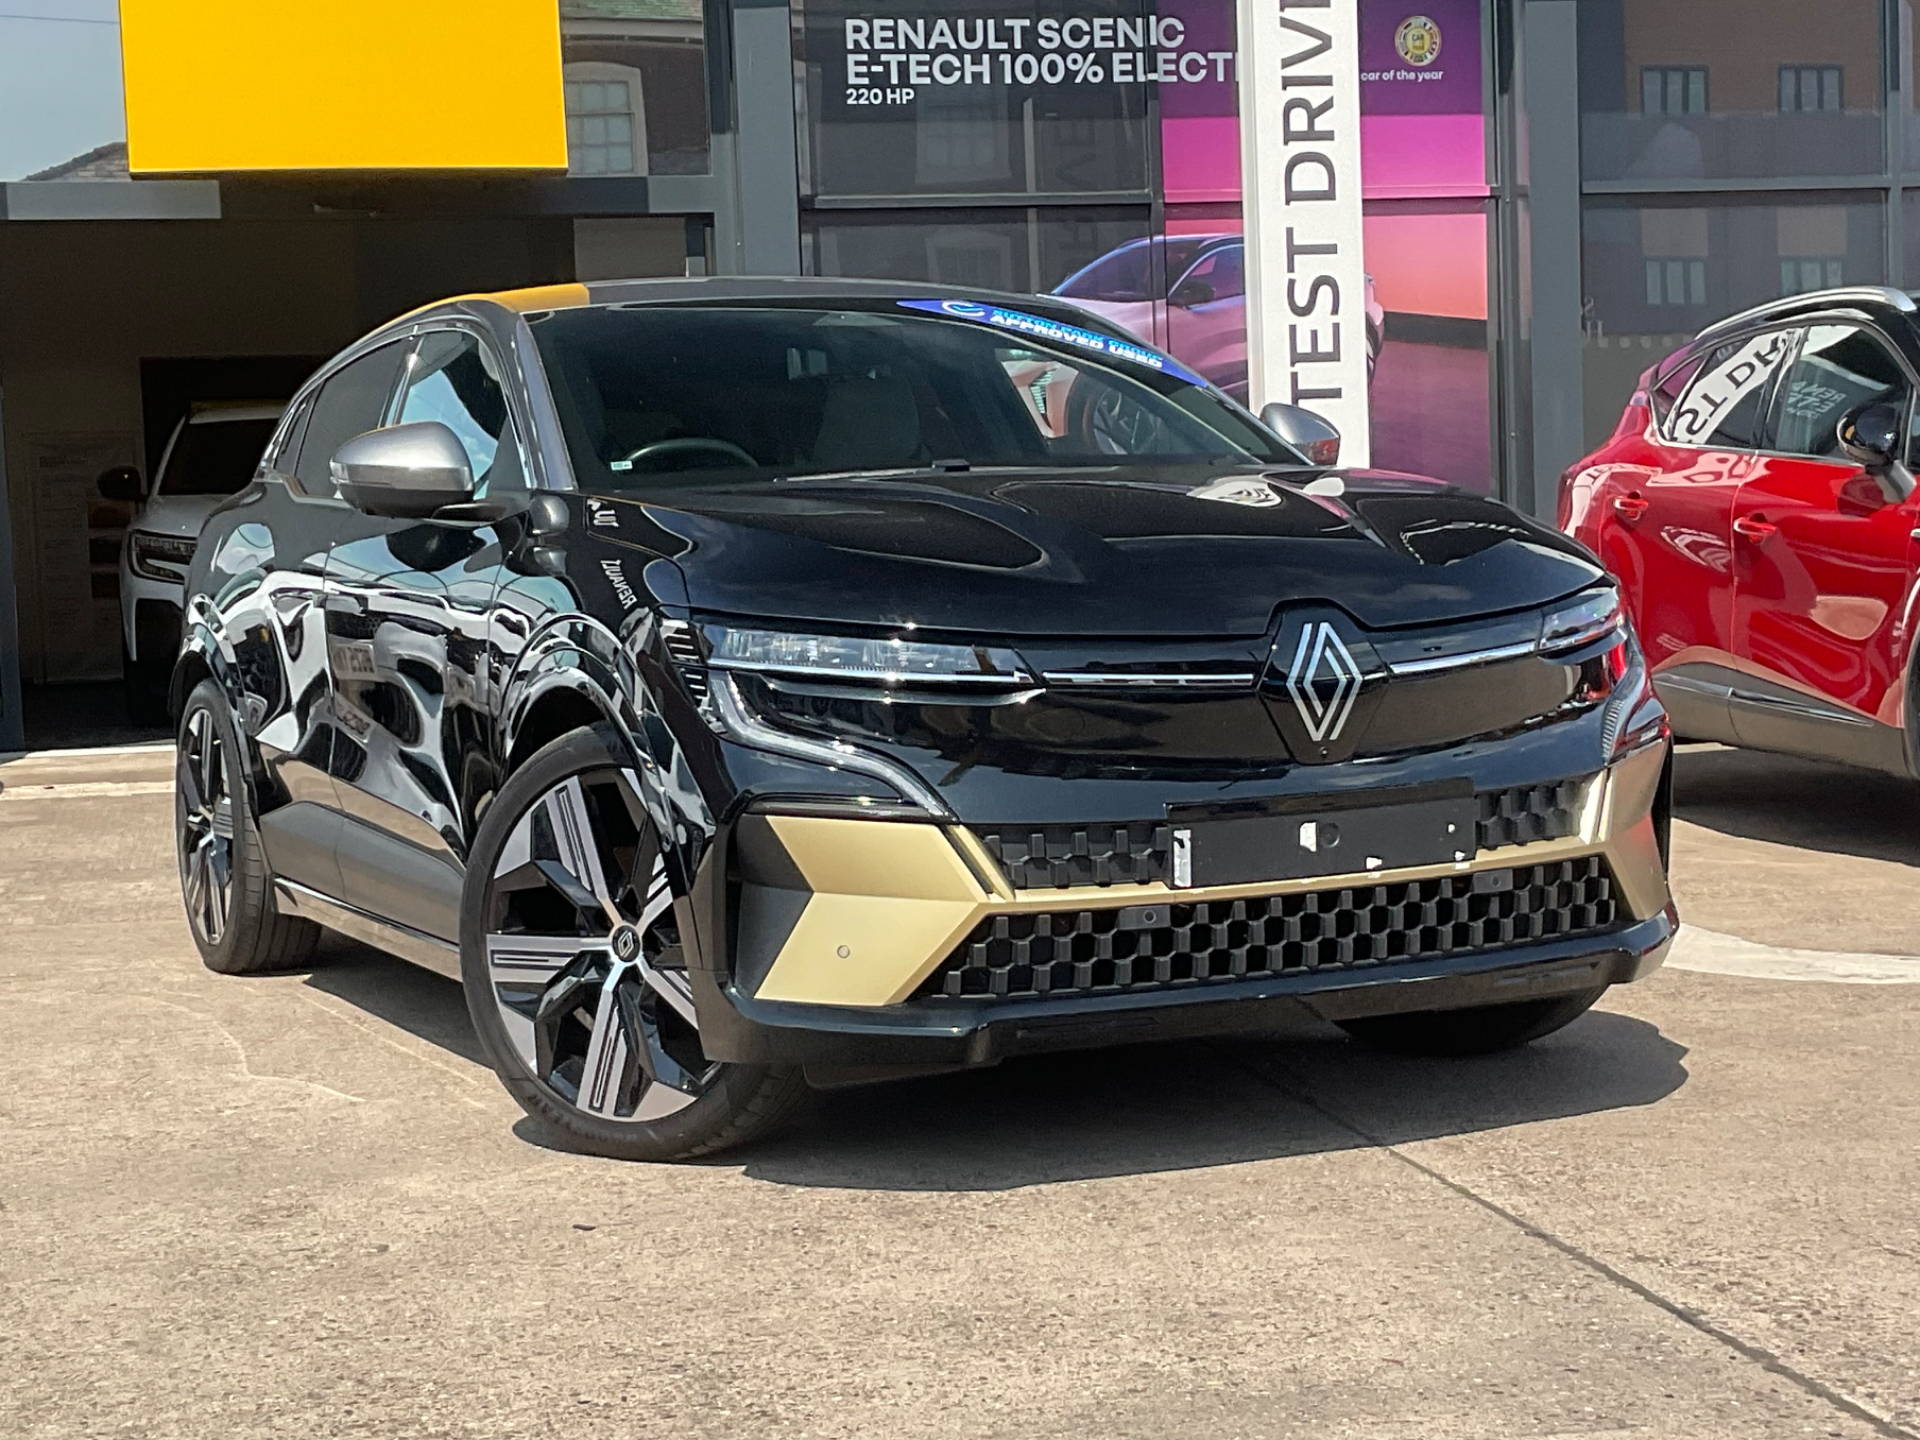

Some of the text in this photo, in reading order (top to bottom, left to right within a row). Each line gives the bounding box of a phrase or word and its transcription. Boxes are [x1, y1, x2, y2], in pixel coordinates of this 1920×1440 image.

[845, 15, 1185, 50] RENAULT SCENIC
[847, 51, 1239, 85] E-TECH 100% ELECT
[1360, 69, 1444, 83] car of the year
[845, 88, 915, 104] 220 HP
[1287, 227, 1342, 406] TEST
[989, 315, 1163, 369] APPROVED USED
